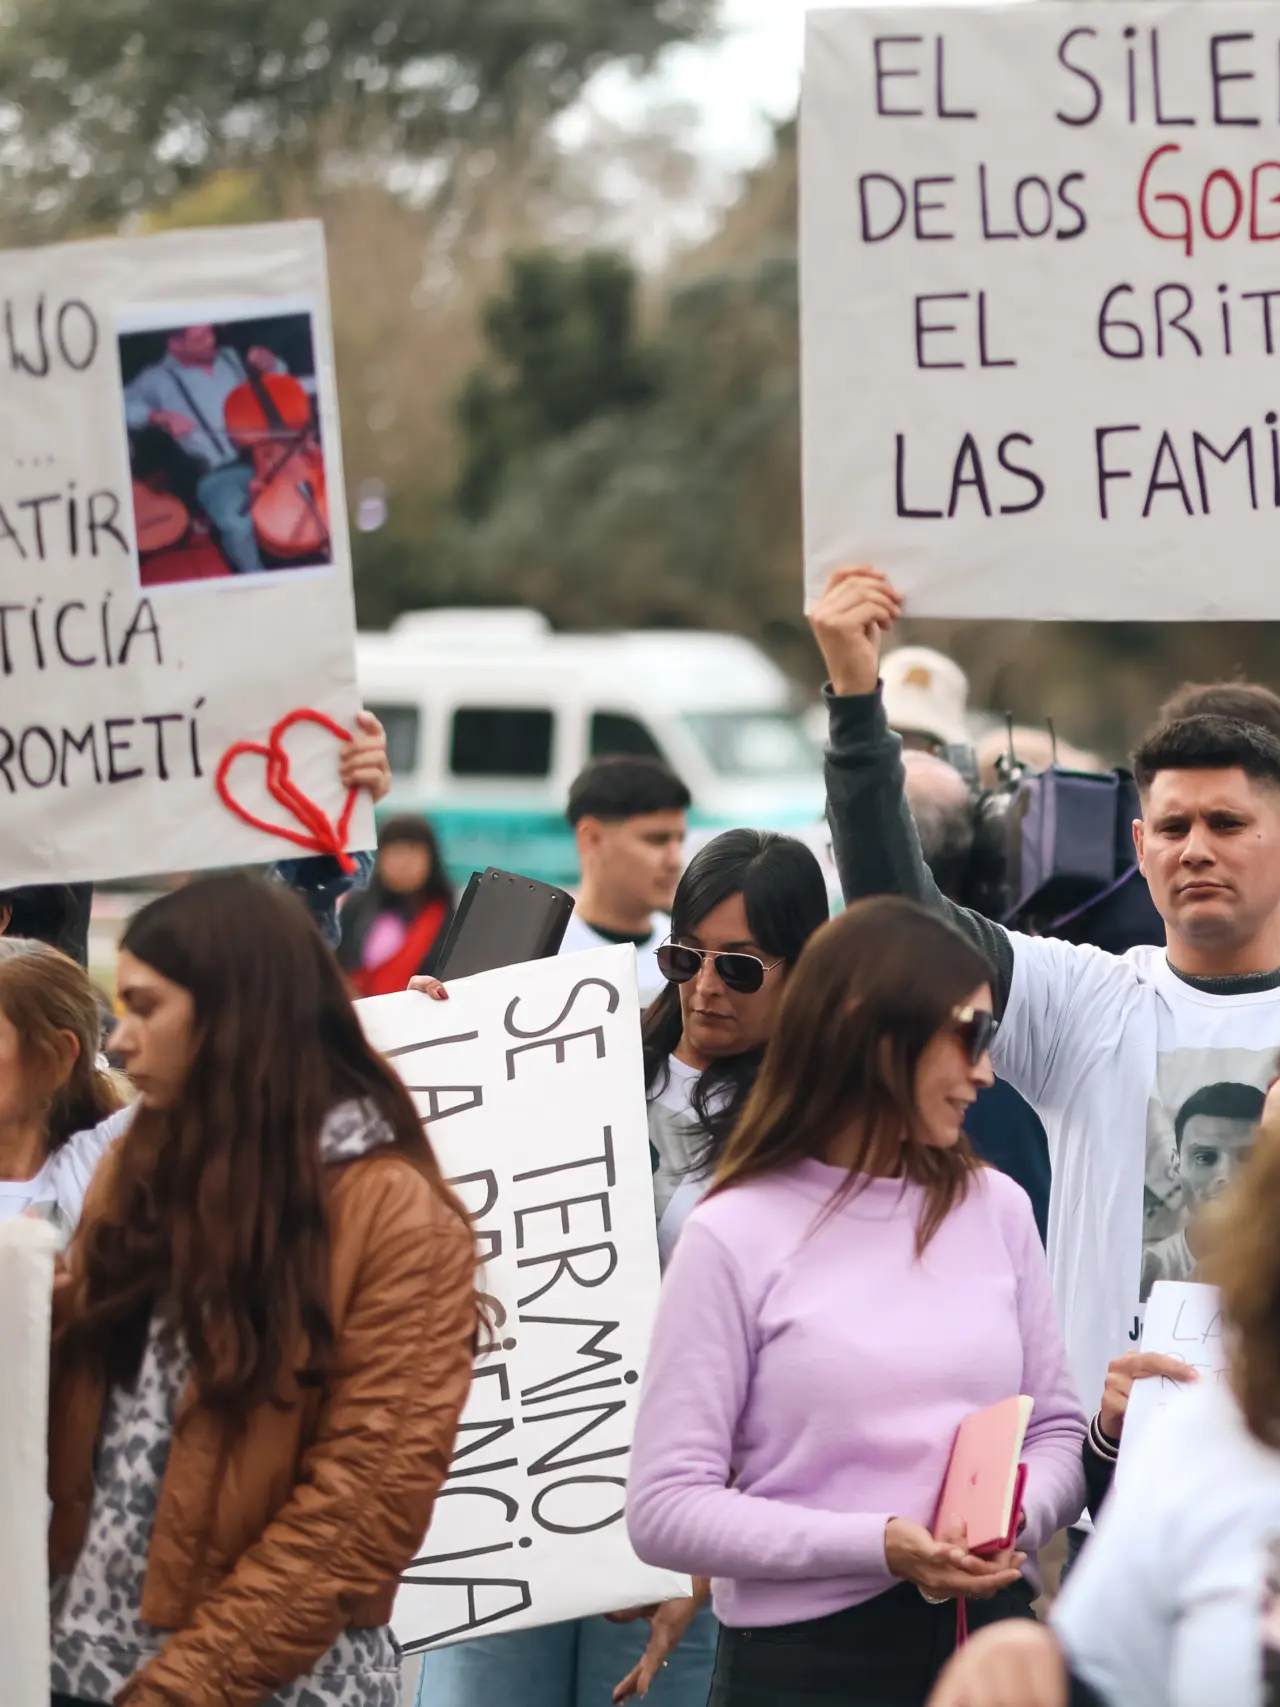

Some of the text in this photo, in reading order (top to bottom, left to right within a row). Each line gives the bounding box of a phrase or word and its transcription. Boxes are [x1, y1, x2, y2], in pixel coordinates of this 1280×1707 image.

[873, 35, 977, 119] EL
[858, 172, 955, 243] DE
[979, 163, 1089, 241] LOS
[914, 292, 1016, 369] EL
[896, 432, 1045, 519] LAS
[503, 976, 619, 1082] SE
